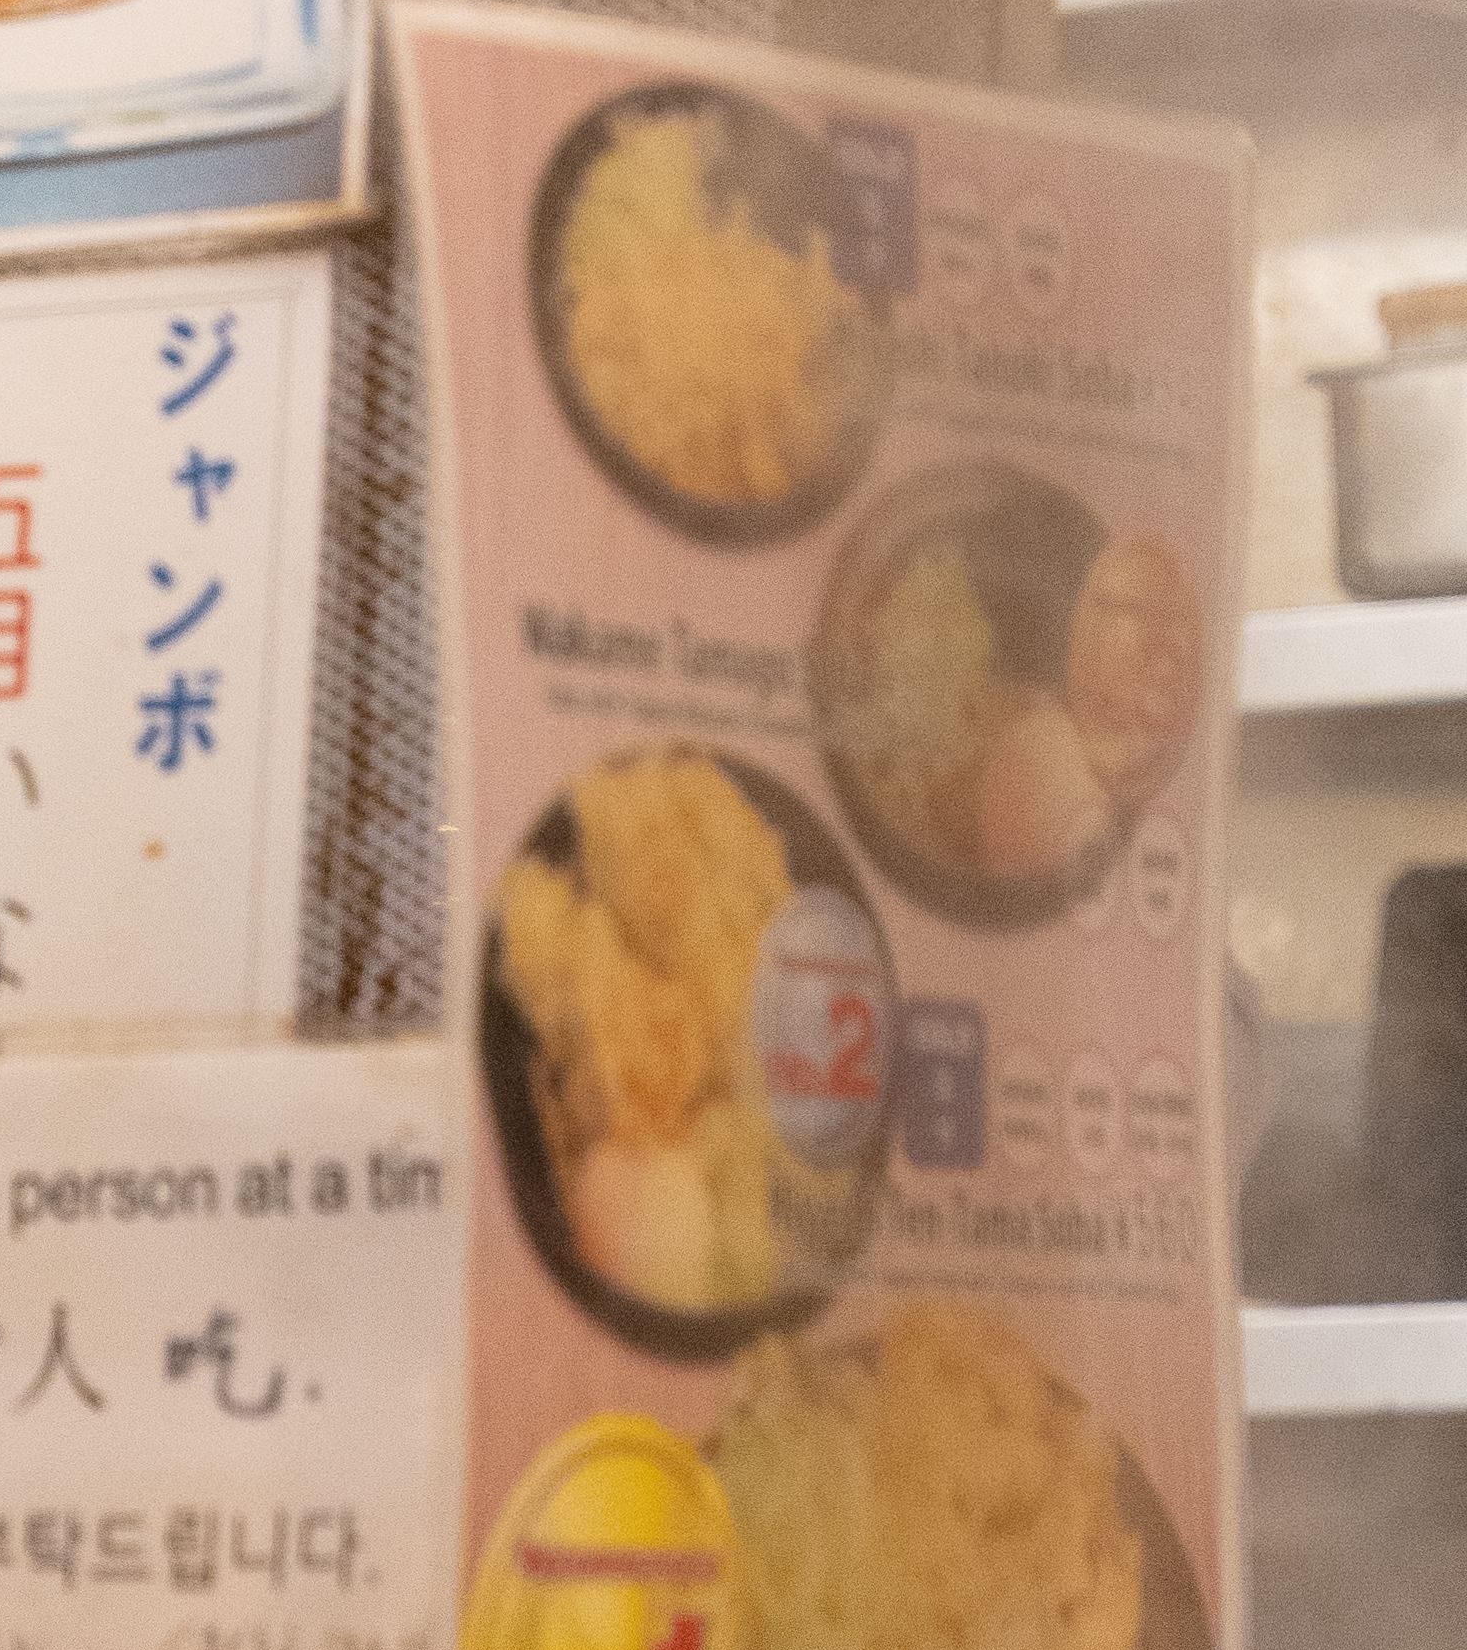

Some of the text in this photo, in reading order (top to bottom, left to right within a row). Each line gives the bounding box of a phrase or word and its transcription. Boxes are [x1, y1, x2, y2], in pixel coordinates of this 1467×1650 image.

[136, 310, 238, 775] ジャンボ
[7, 1168, 220, 1237] person
[234, 1154, 294, 1218] at
[312, 1162, 348, 1214] a
